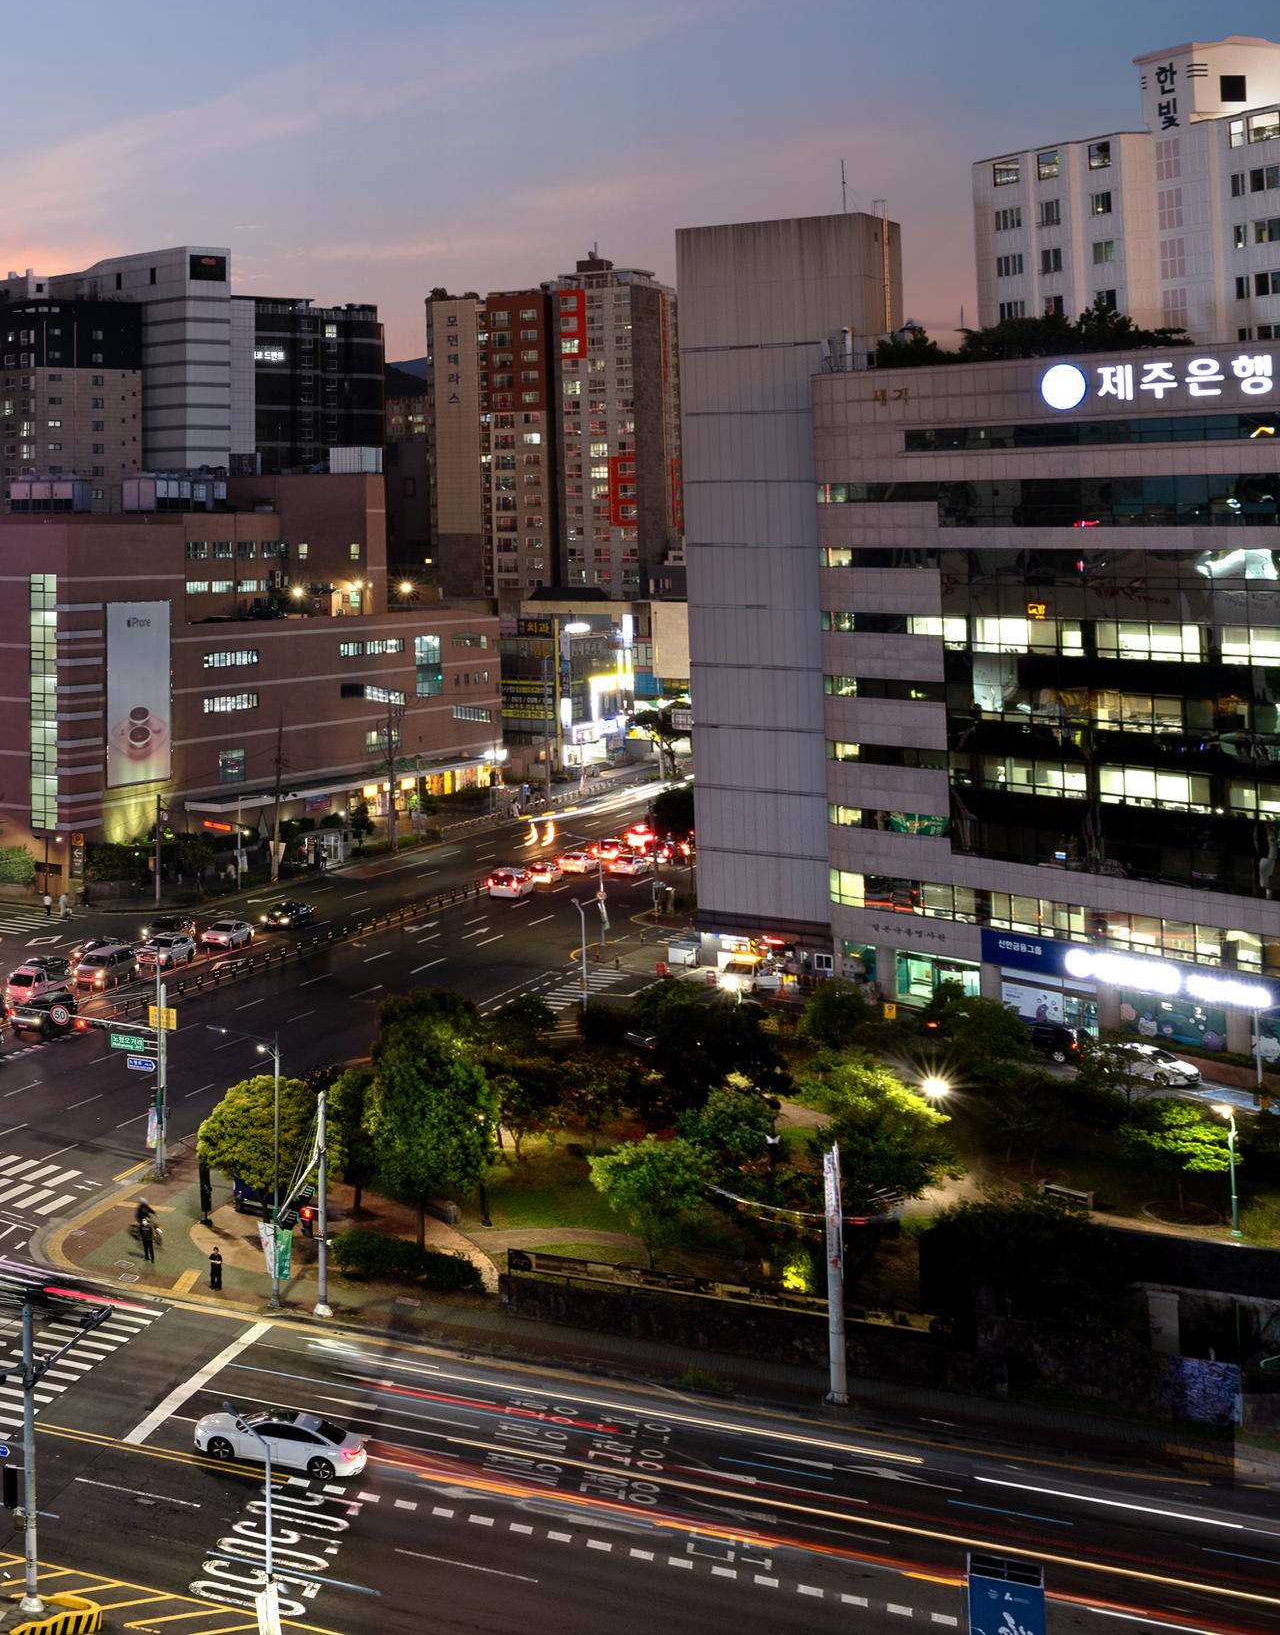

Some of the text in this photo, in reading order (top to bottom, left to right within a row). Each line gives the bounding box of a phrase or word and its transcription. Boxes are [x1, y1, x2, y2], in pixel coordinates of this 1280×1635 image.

[1154, 61, 1180, 131] 한빛
[446, 315, 461, 404] 모던테라스
[1097, 353, 1273, 402] 제주은행
[998, 939, 1042, 956] 신한금융그룹
[54, 1010, 66, 1021] 50
